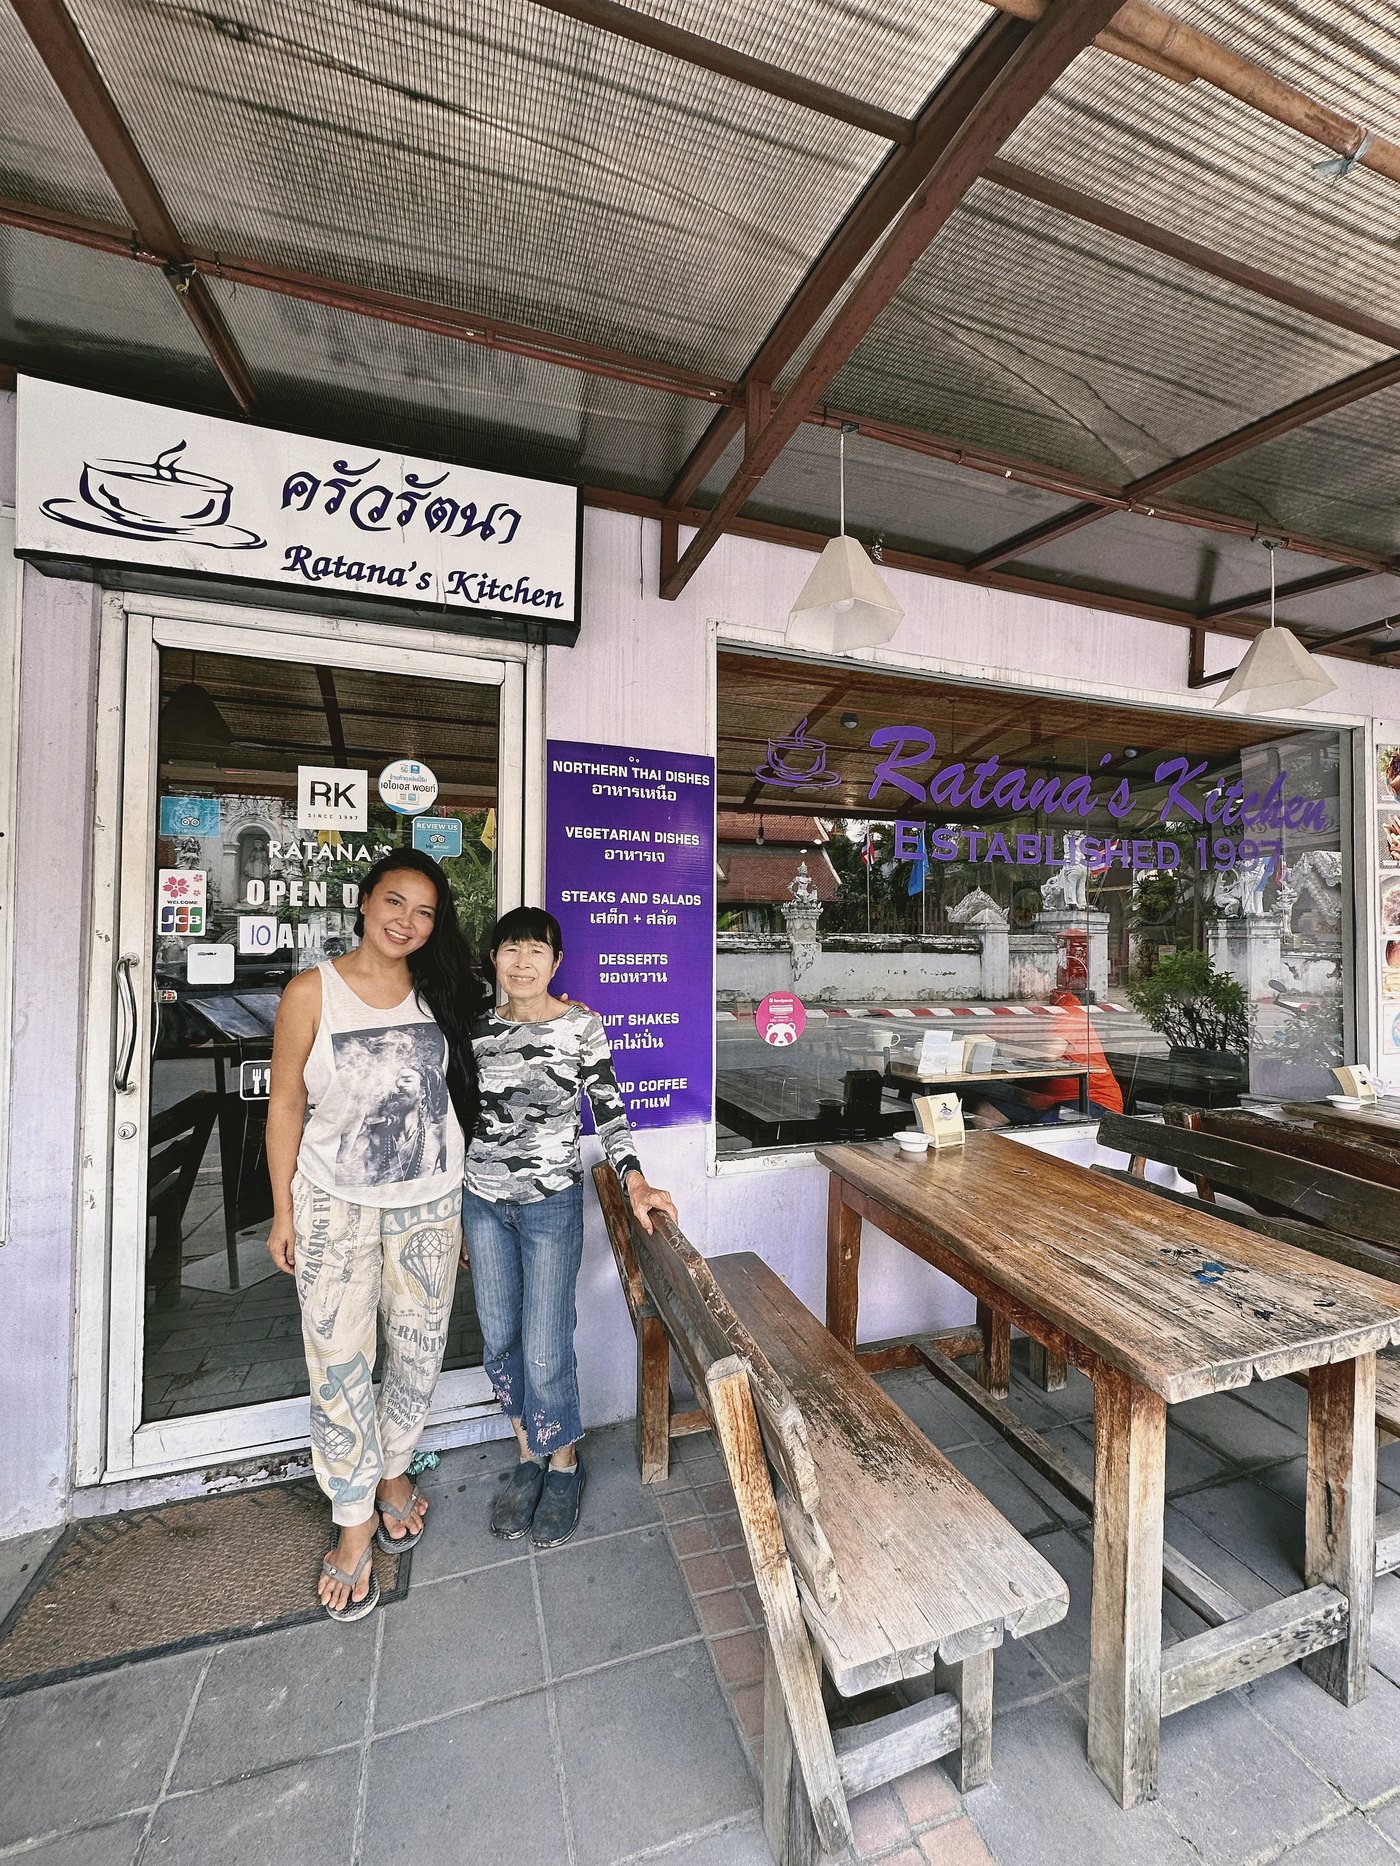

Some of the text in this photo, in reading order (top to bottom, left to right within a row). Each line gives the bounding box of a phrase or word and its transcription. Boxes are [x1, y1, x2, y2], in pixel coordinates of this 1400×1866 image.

[280, 458, 522, 544] ครัวรัตนา
[280, 544, 564, 609] Ratana's Kitchen
[553, 760, 710, 786] NORTHERN THAI DISHES
[867, 724, 1330, 831] Ratana's Kitchen
[380, 780, 410, 791] เอไอเอส
[592, 783, 677, 801] อาหารเหนือ
[309, 780, 356, 809] RK
[416, 822, 446, 830] REVIEW
[565, 826, 700, 846] VEGETARIAN DISHES
[894, 819, 1181, 871] ESTABLISHED
[1197, 837, 1284, 873] 1997
[604, 848, 665, 863] อาหารเจ
[246, 879, 327, 907] OPEN
[561, 890, 701, 906] STEAKS AND SALADS
[590, 908, 629, 925] เสต็ก
[646, 909, 677, 925] สลัด
[599, 953, 669, 966] DESSERTS
[599, 972, 668, 983] ของหวาน
[628, 1013, 680, 1025] SHAKES
[617, 1077, 688, 1094] ND COFFEE
[630, 1094, 671, 1110] กาแฟ
